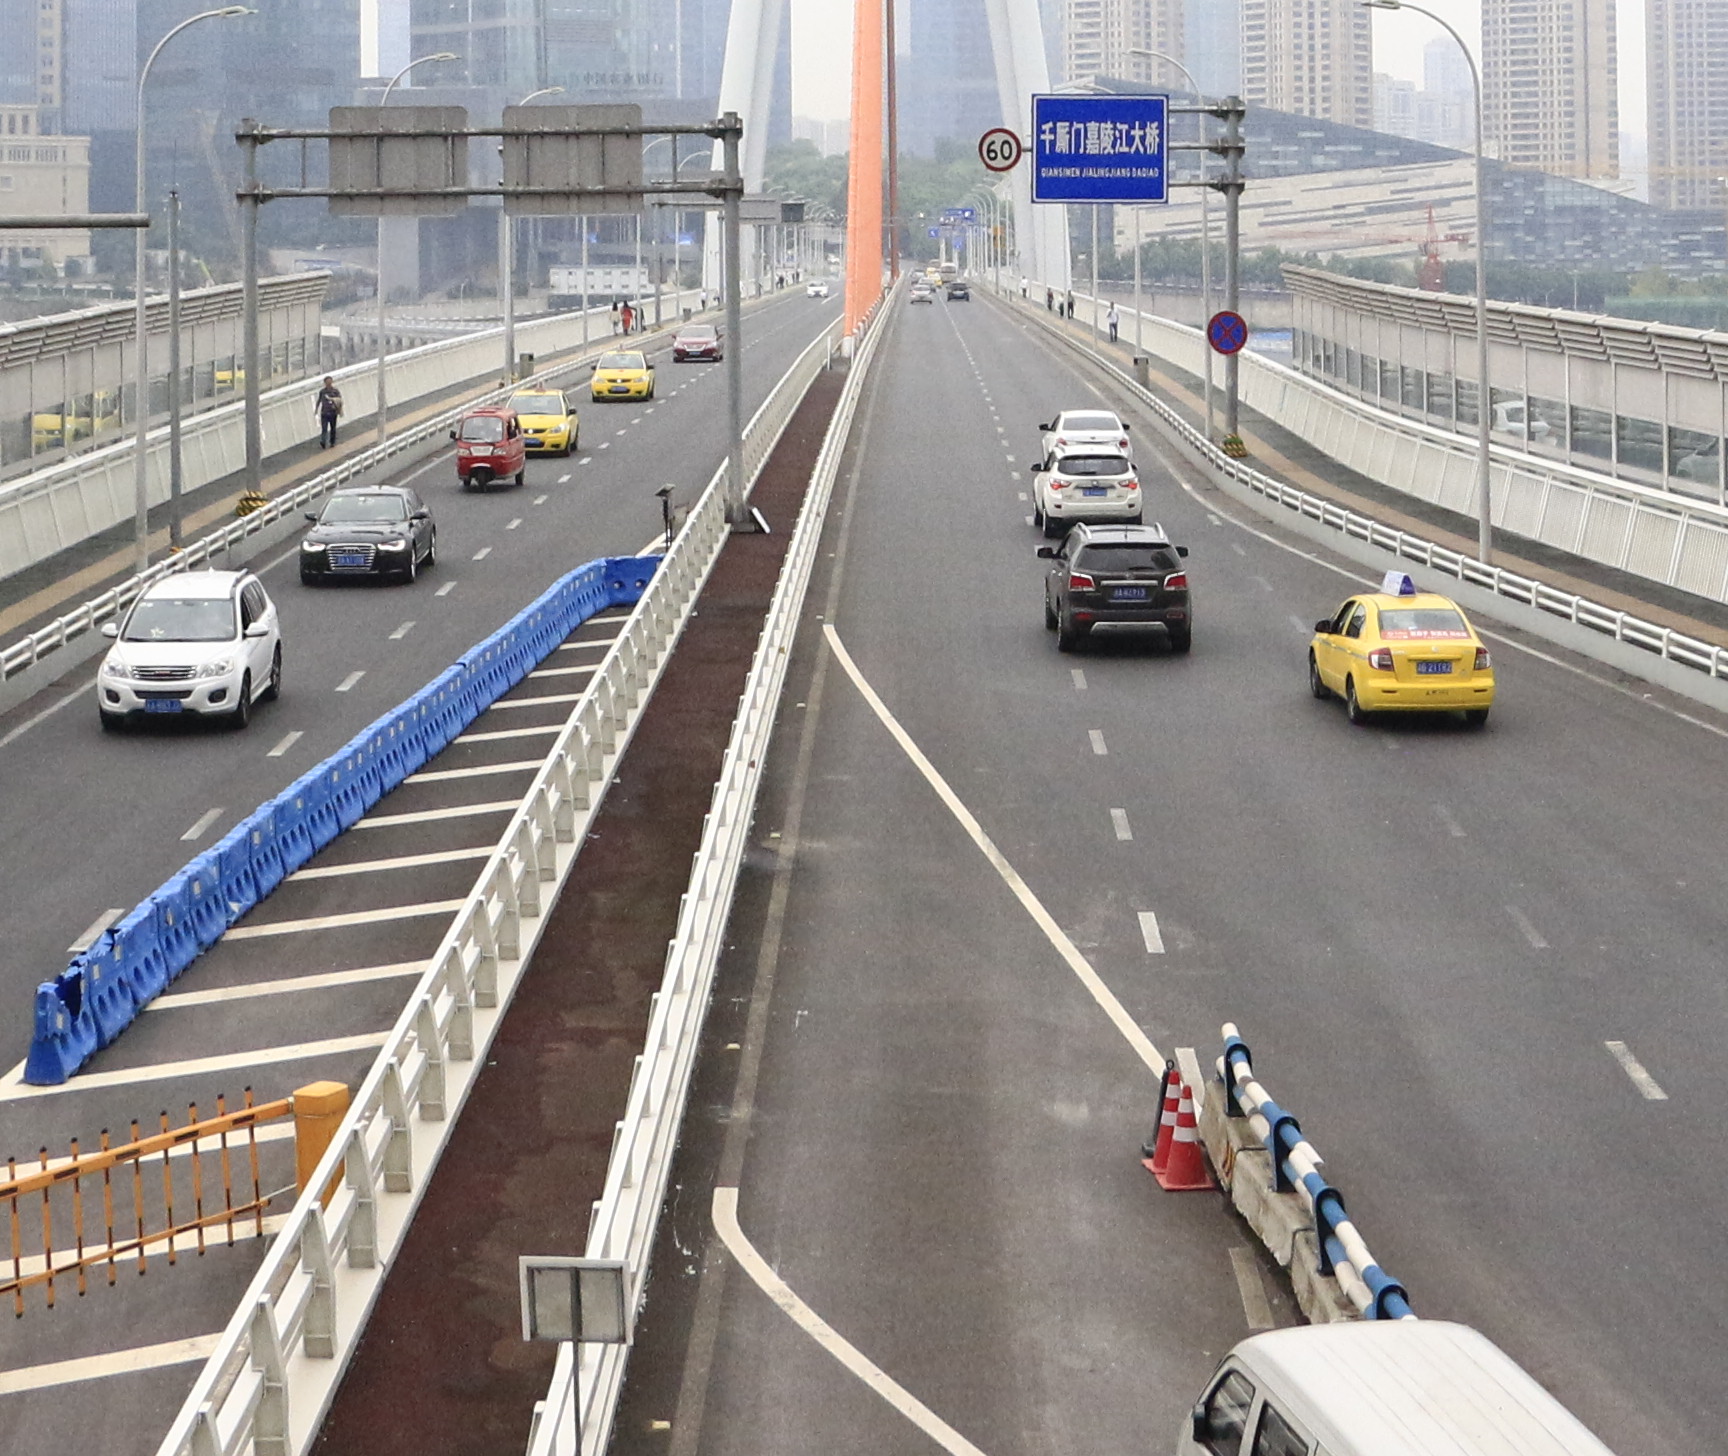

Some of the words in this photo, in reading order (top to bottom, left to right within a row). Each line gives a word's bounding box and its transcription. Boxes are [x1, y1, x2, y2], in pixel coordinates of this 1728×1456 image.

[986, 140, 1012, 161] 60
[1040, 121, 1160, 155] 千厮门嘉陵江大桥
